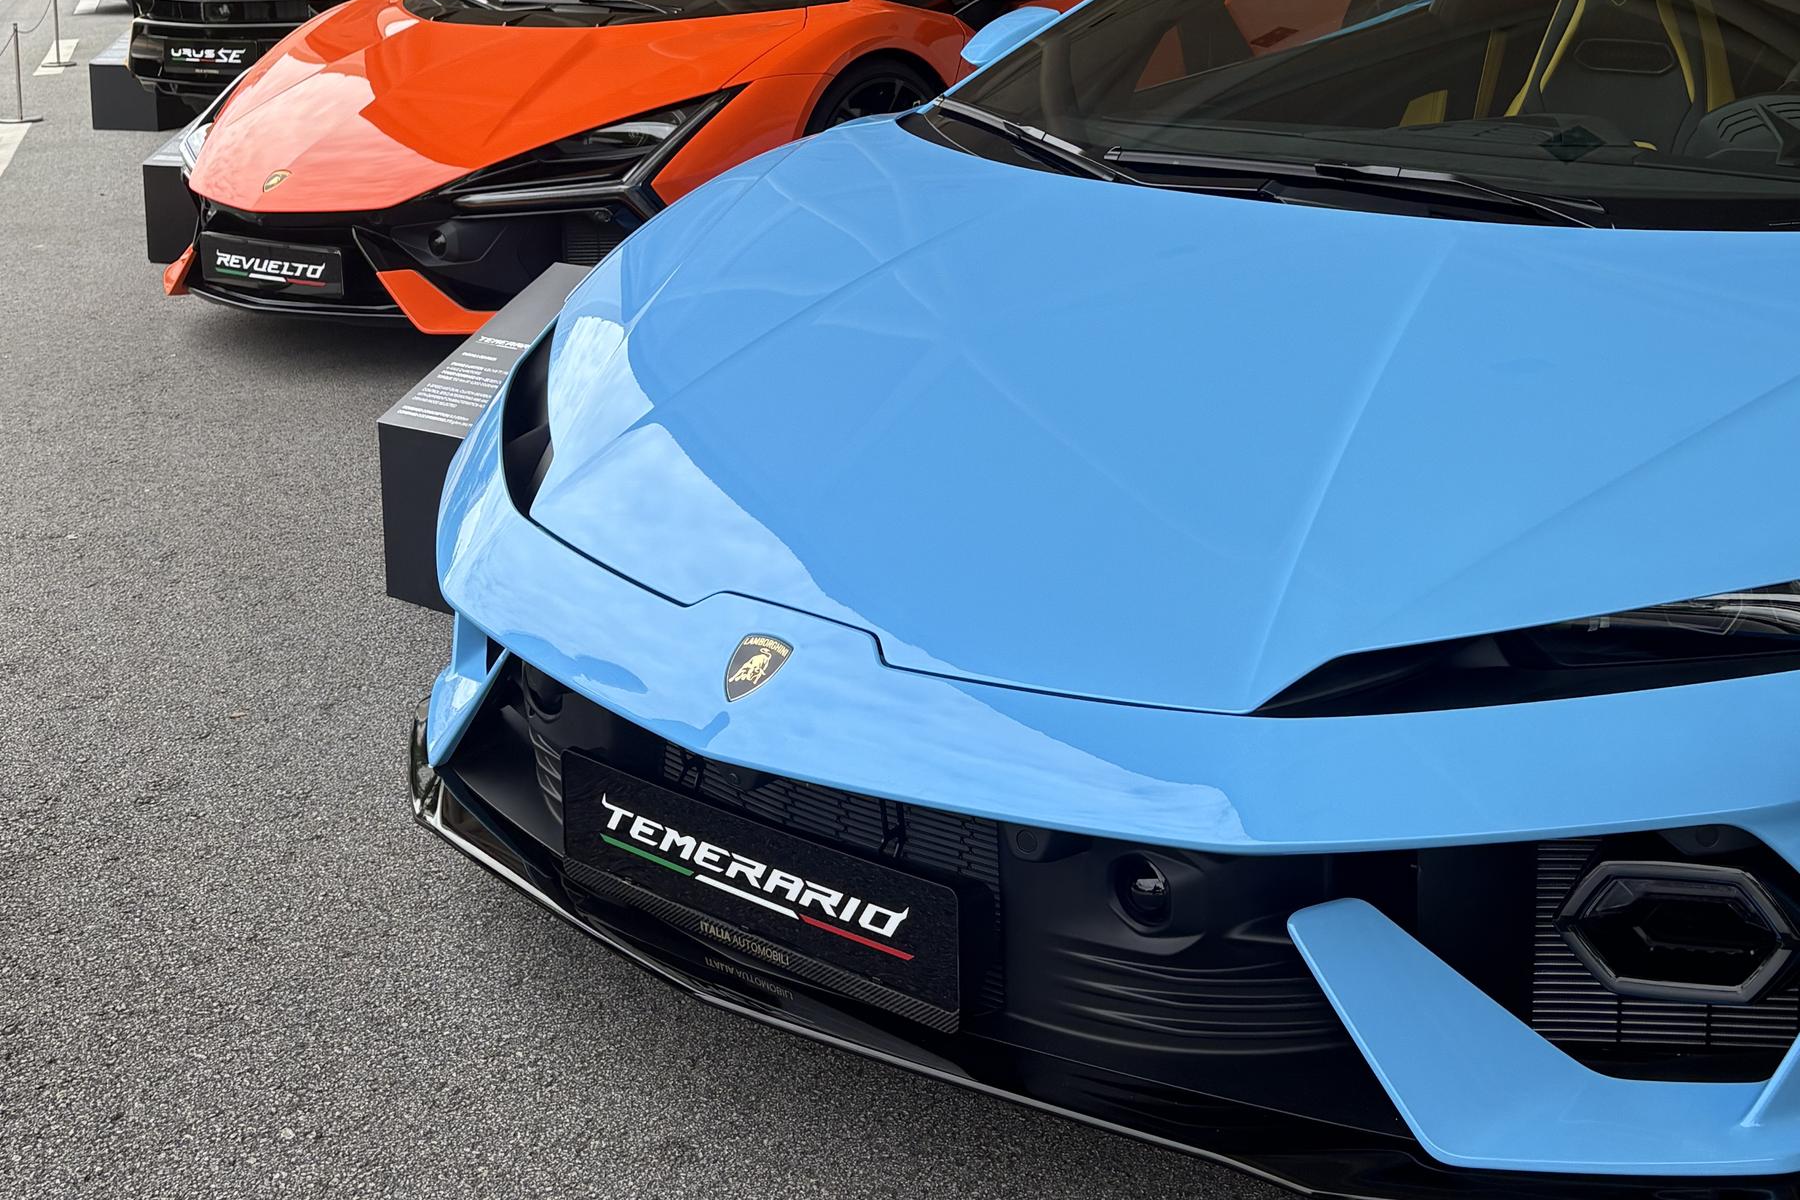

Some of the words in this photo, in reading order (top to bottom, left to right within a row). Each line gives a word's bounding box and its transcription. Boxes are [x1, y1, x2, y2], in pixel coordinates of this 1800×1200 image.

[170, 47, 215, 59] URUS
[215, 47, 247, 63] SE
[216, 249, 326, 279] REVUELTO
[743, 636, 790, 658] LAMBORGHINI
[601, 792, 910, 938] TEMERARIO
[700, 920, 731, 942] ITALIA
[732, 934, 790, 967] AUTOMOBILI
